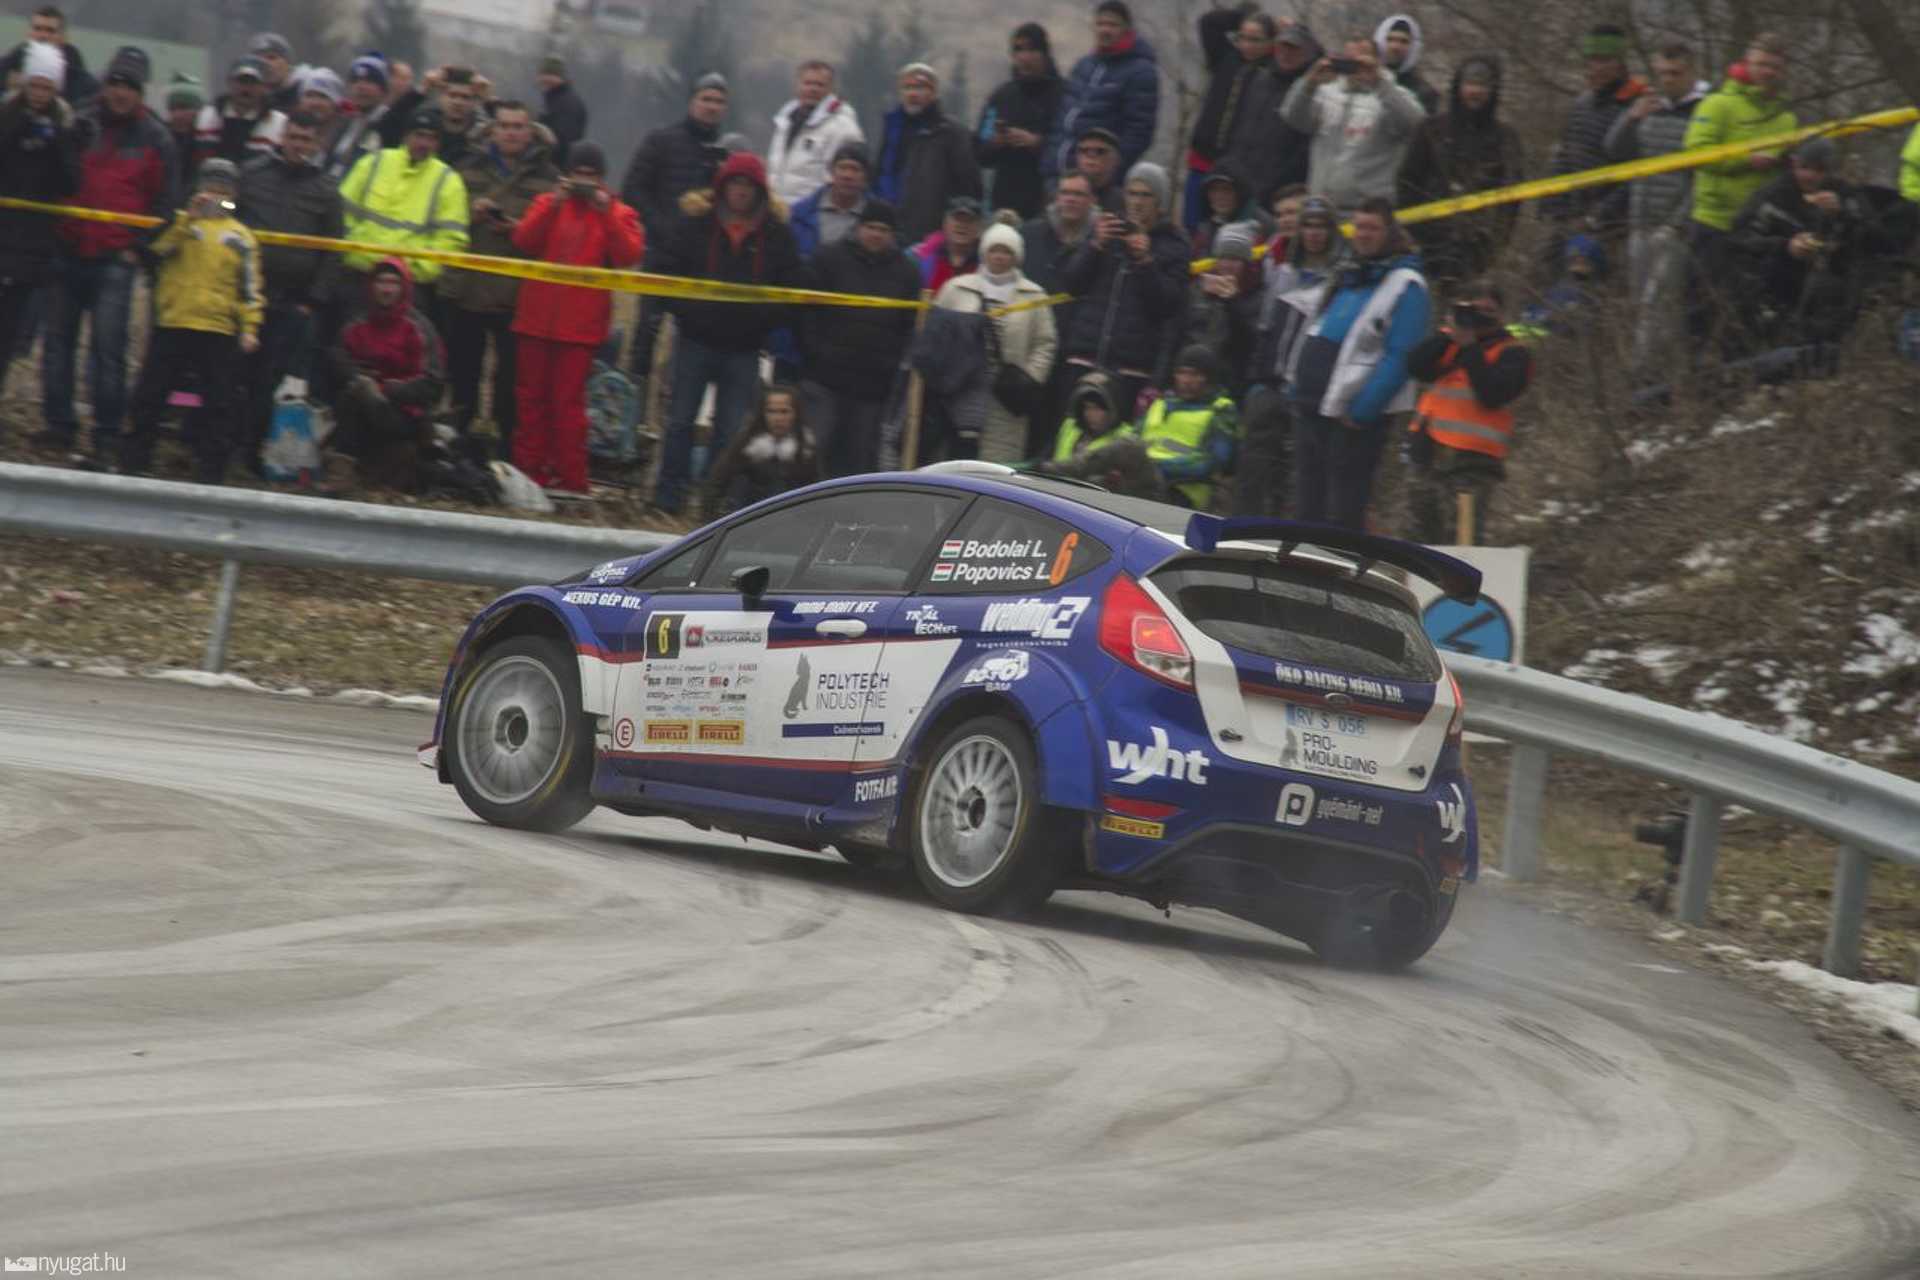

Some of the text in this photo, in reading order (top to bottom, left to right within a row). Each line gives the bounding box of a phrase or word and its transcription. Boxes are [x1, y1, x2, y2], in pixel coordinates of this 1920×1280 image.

[962, 540, 1048, 558] Bodolai L.
[1050, 531, 1079, 586] 6
[953, 562, 1033, 585] Popovics
[658, 618, 671, 654] 6
[817, 673, 889, 690] POLYTECH
[816, 691, 888, 709] INDUSTRIE
[621, 726, 630, 741] E
[648, 724, 689, 740] PIRELLI
[700, 724, 740, 740] PIRELLI
[1302, 732, 1337, 751] PRO-
[1303, 748, 1378, 775] MOULDING
